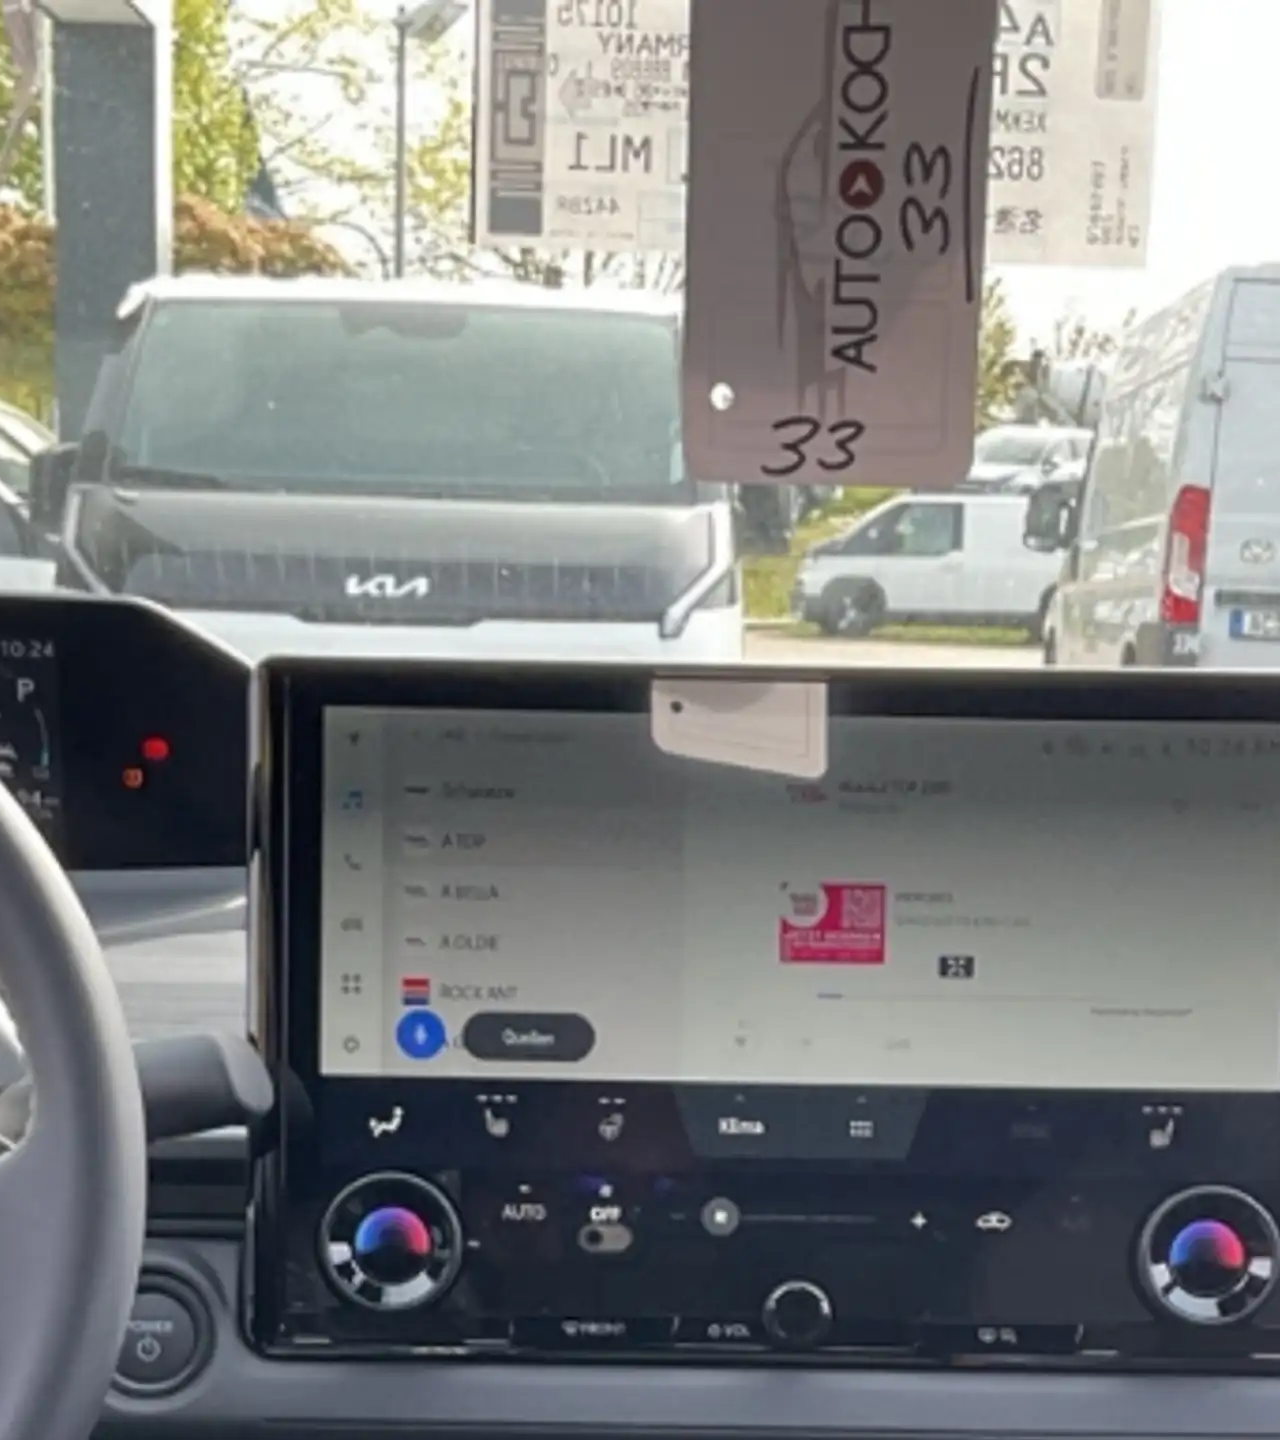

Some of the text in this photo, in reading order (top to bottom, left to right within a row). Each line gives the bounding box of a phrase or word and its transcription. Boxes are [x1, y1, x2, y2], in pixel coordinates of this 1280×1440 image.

[900, 141, 952, 255] 33
[760, 414, 866, 476] 33
[16, 678, 36, 703] P
[501, 1202, 548, 1221] AUTO
[589, 1204, 622, 1222] OFF
